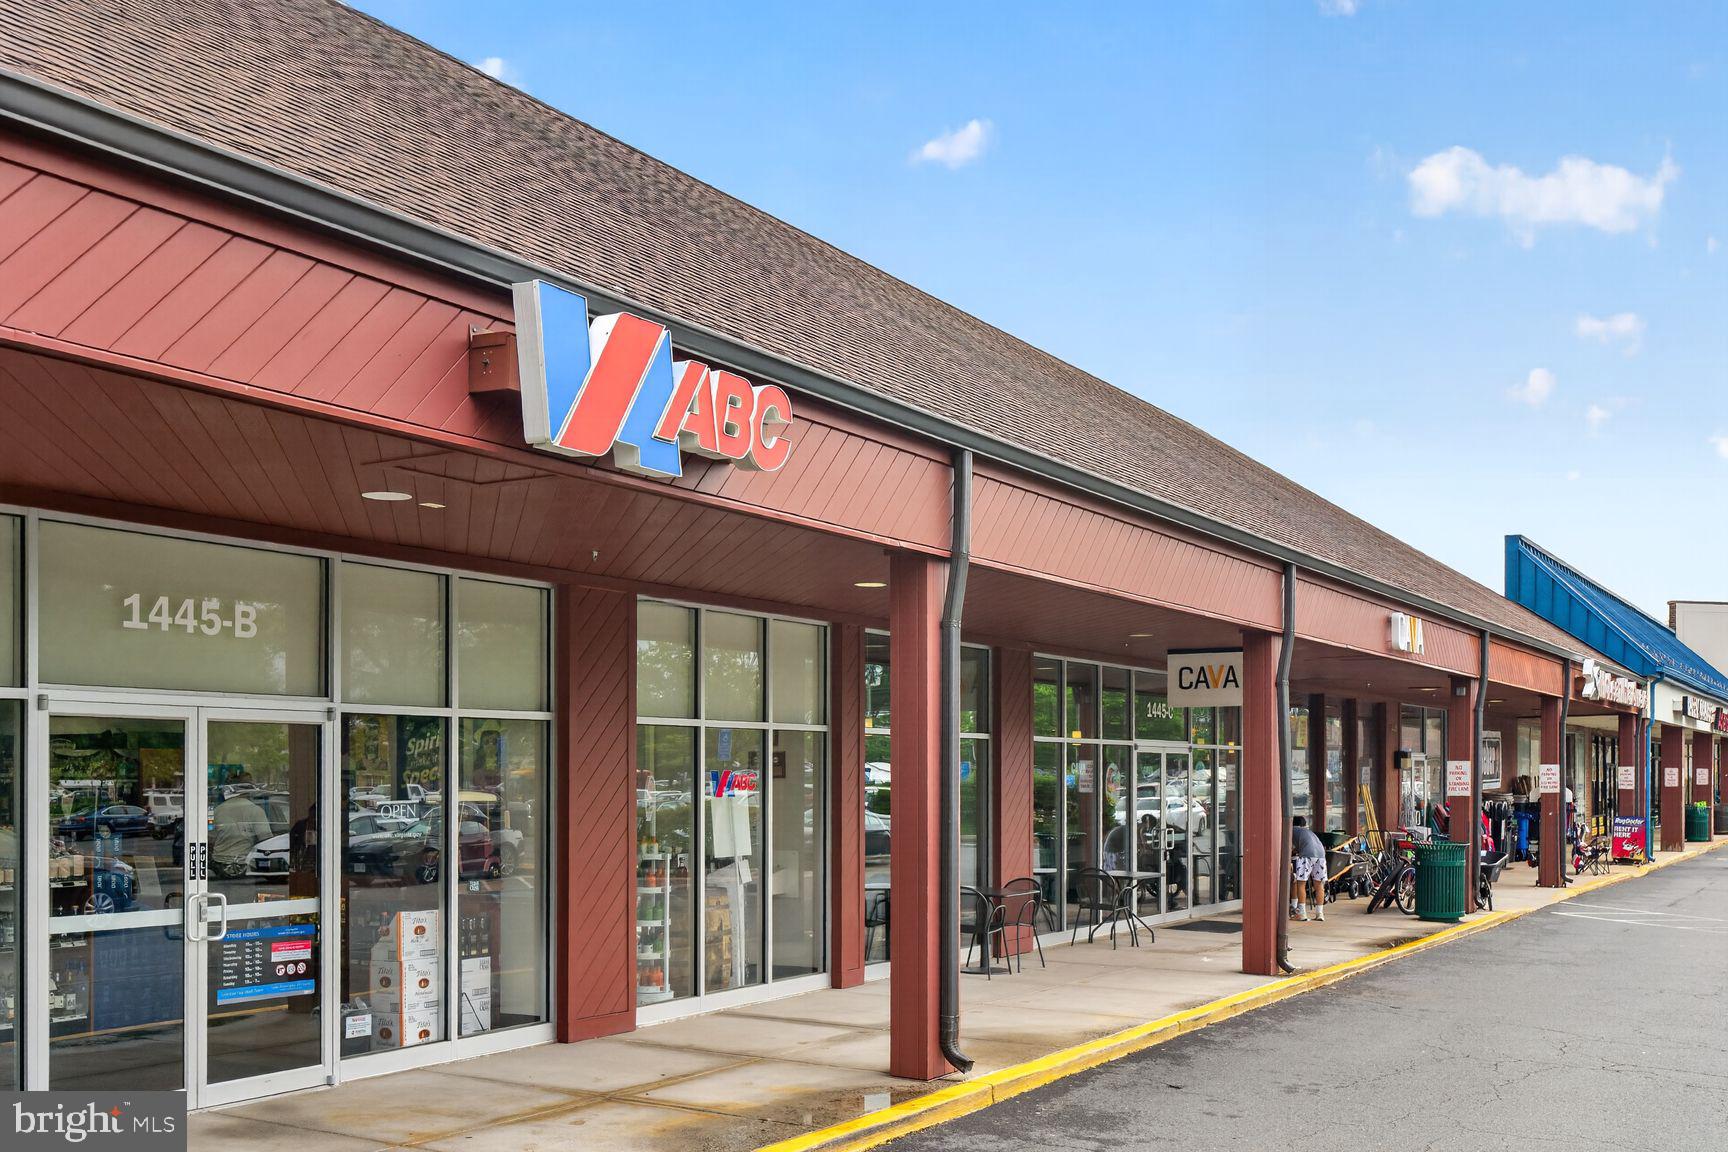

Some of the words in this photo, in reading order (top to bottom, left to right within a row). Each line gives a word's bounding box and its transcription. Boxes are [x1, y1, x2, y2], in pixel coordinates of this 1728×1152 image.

[652, 360, 793, 472] ABC
[123, 593, 258, 638] 1445-B
[1178, 664, 1240, 690] CAVA
[1146, 701, 1174, 719] 1445-C
[730, 773, 757, 791] ABC
[380, 804, 417, 820] OPEN
[189, 846, 197, 878] PULL
[199, 846, 207, 878] PULL
